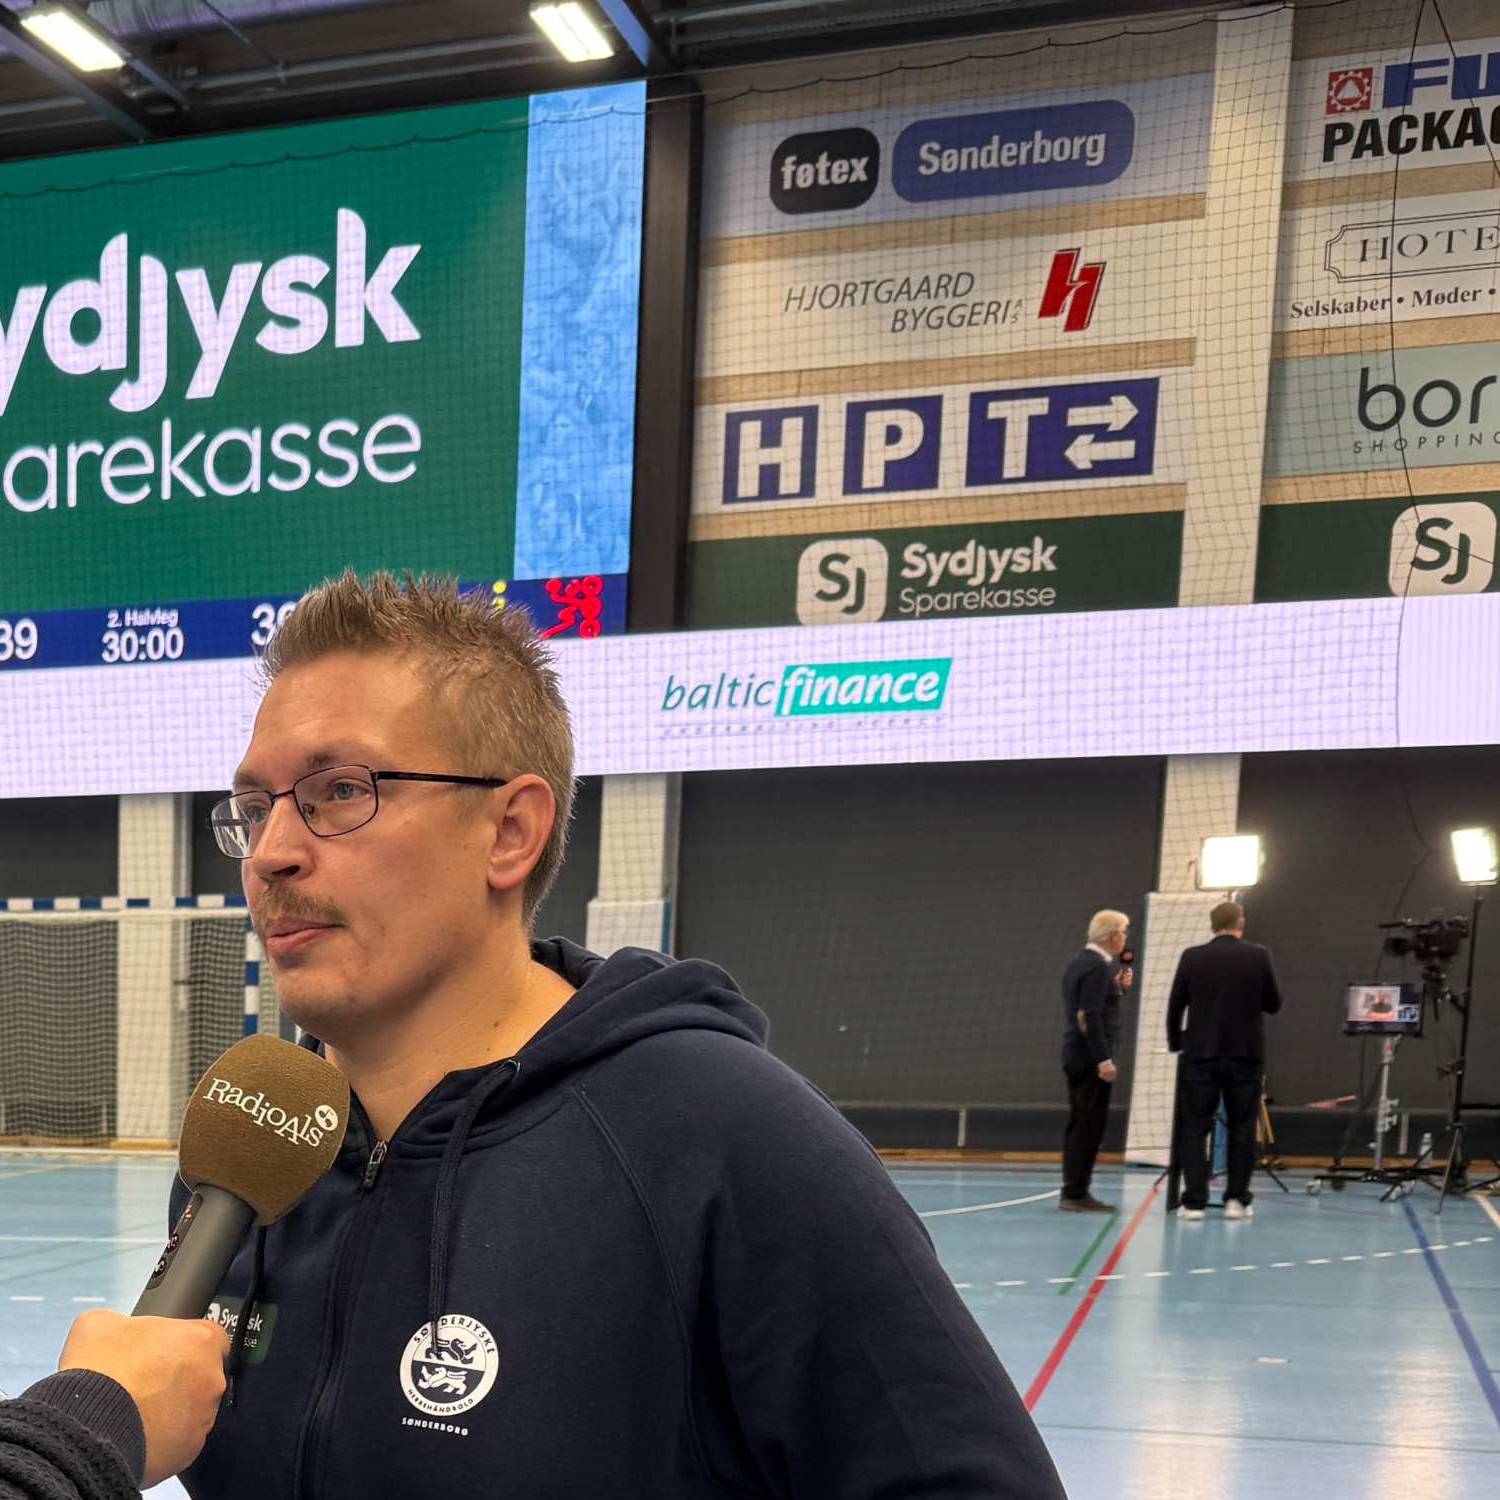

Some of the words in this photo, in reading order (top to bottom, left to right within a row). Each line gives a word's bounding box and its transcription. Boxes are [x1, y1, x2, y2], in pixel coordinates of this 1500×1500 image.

[918, 131, 1106, 176] Sønderborg
[1323, 106, 1500, 163] PACKA
[780, 154, 869, 190] føtex
[784, 272, 974, 313] HJORTGAARD
[1291, 296, 1391, 319] Selskaber
[1411, 287, 1482, 308] Møder
[890, 300, 1011, 333] BYGGERI
[901, 536, 1058, 587] Sydjysk
[899, 584, 1056, 617] Sparekasse
[101, 627, 184, 663] 30:00
[661, 672, 775, 711] baltic
[781, 666, 940, 716] finance
[414, 1316, 495, 1354] SØDERJYSKE
